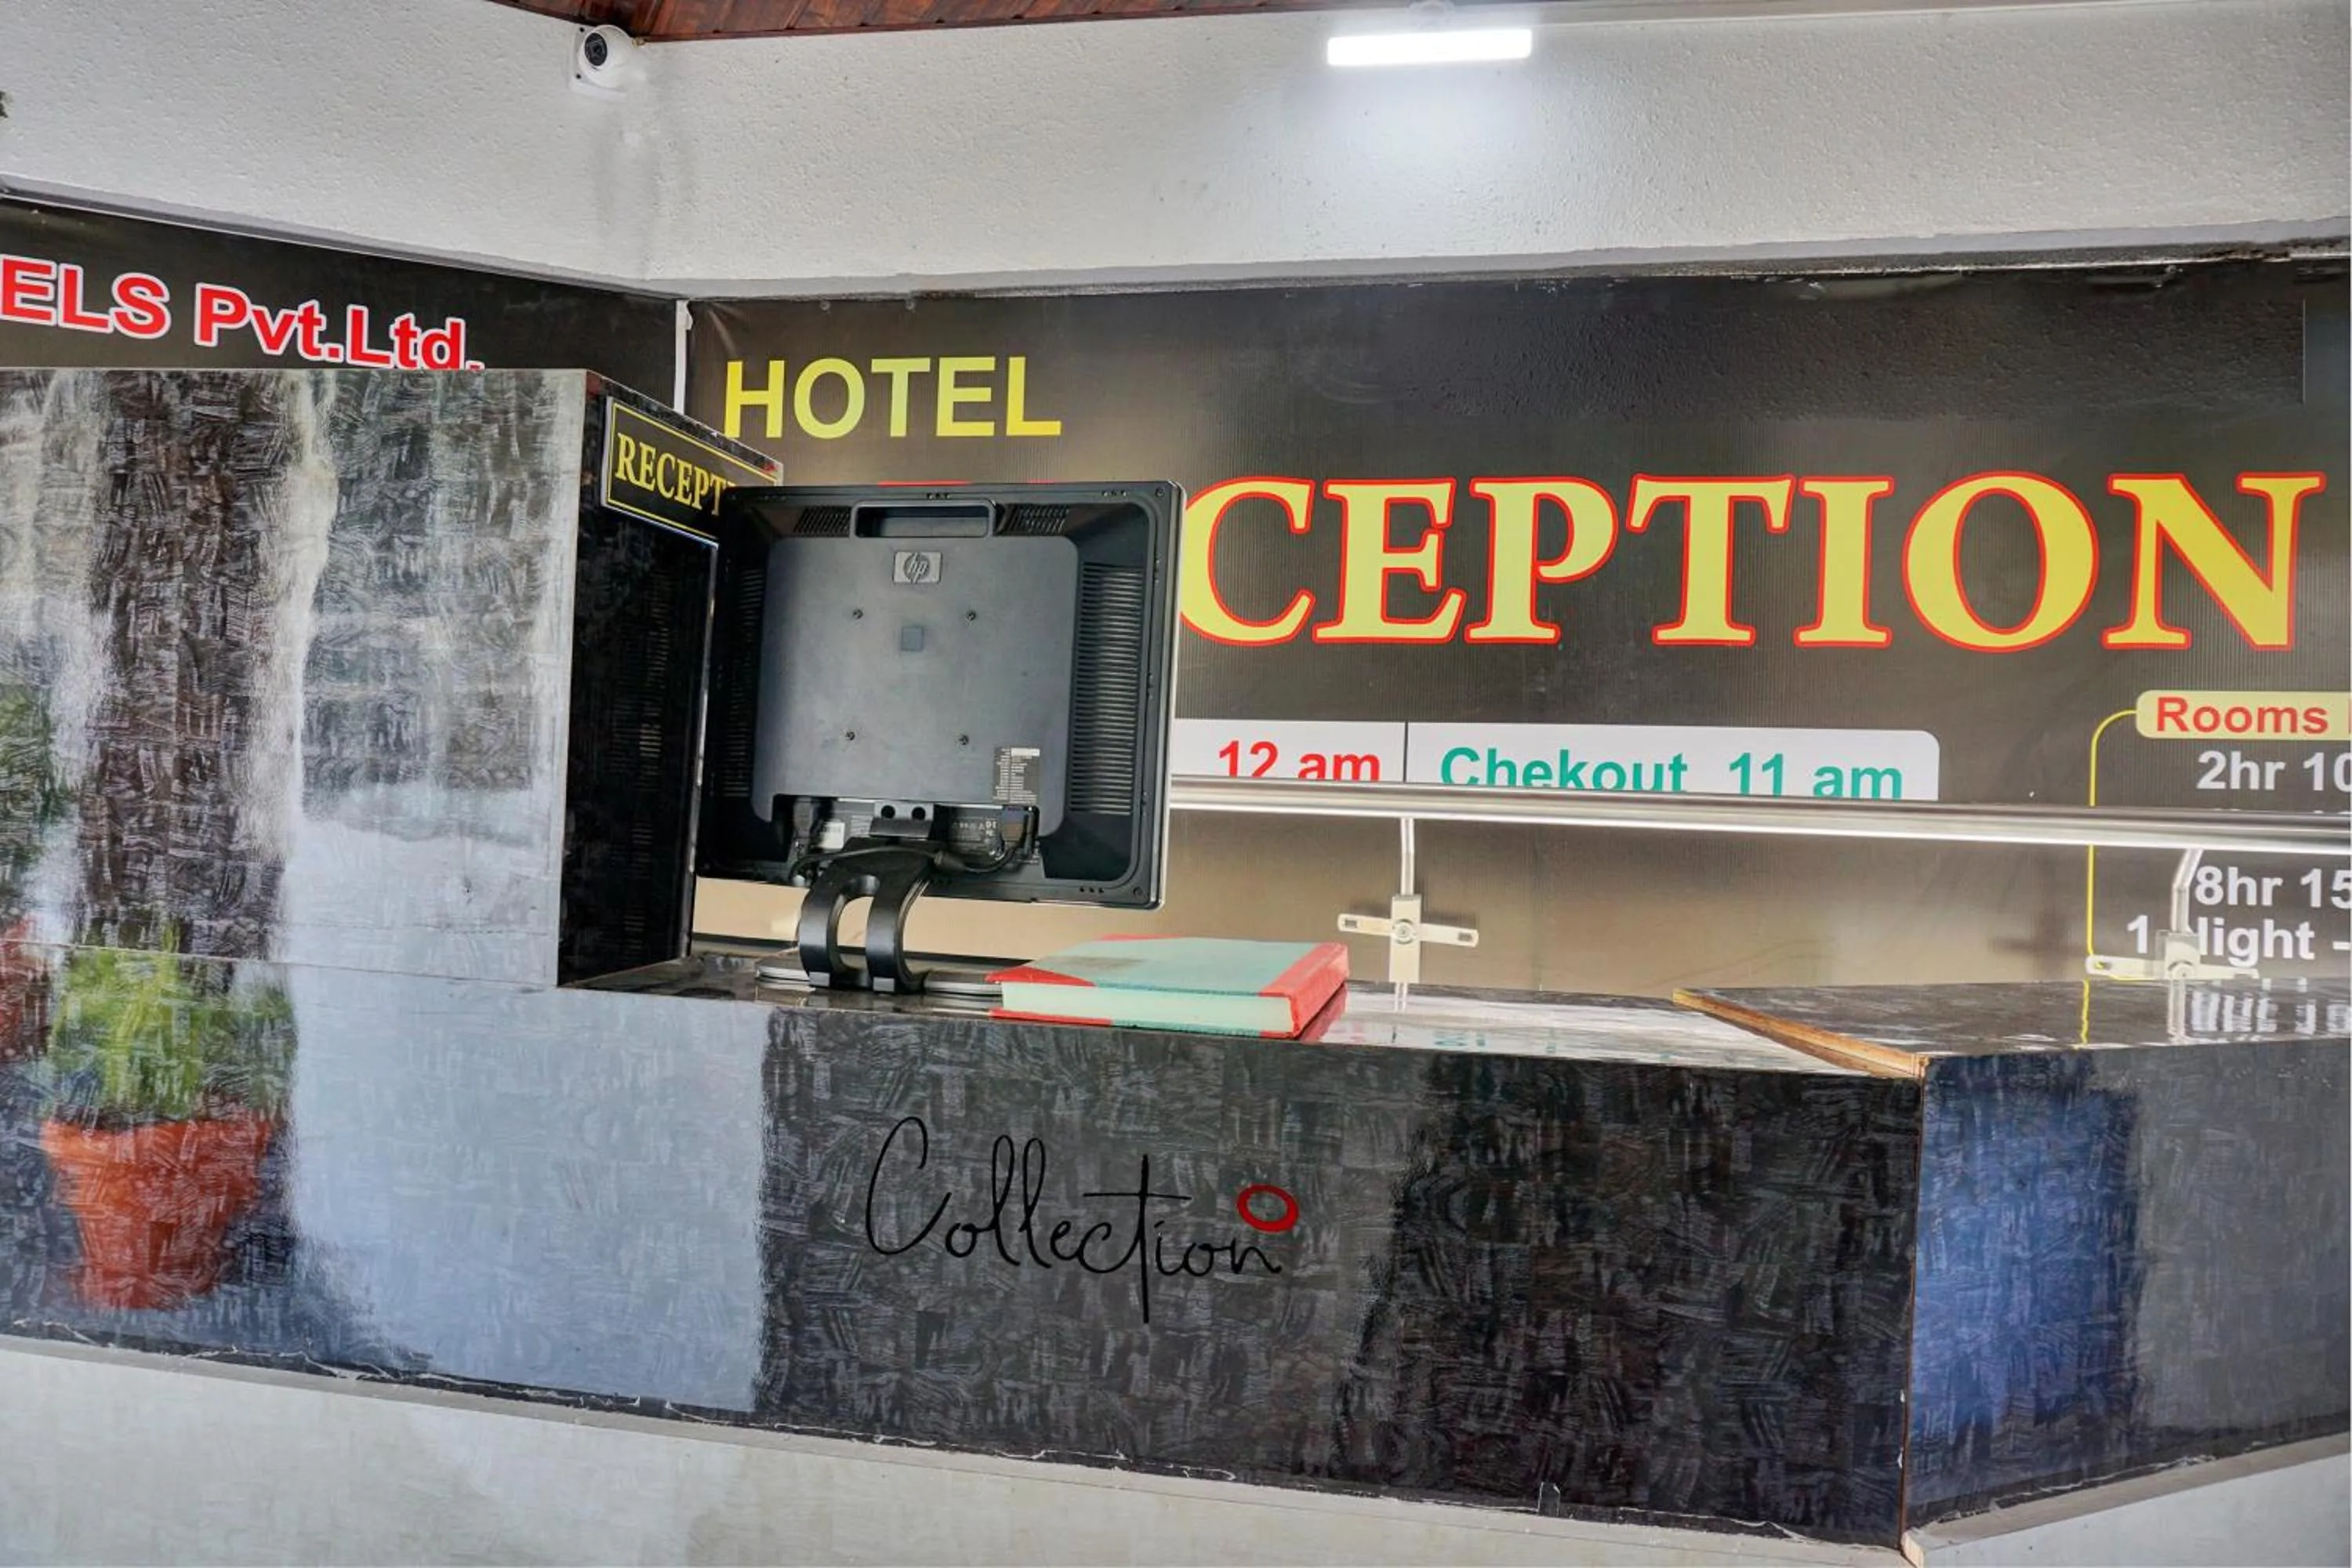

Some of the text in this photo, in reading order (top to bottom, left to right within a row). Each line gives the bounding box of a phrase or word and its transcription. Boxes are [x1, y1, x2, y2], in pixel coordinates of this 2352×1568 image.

[0, 254, 171, 339] ELS
[724, 357, 1062, 439] HOTEL
[615, 432, 736, 517] RECEPT
[1180, 473, 2325, 650] CEPTION
[2156, 697, 2328, 735] Rooms
[1218, 740, 1381, 782] 12 am
[1441, 747, 1903, 802] Chekout 11 am
[2197, 750, 2286, 791] 2hr
[2194, 866, 2283, 906] 8hr
[2127, 915, 2148, 954] 1
[866, 1116, 1282, 1323] Collection
